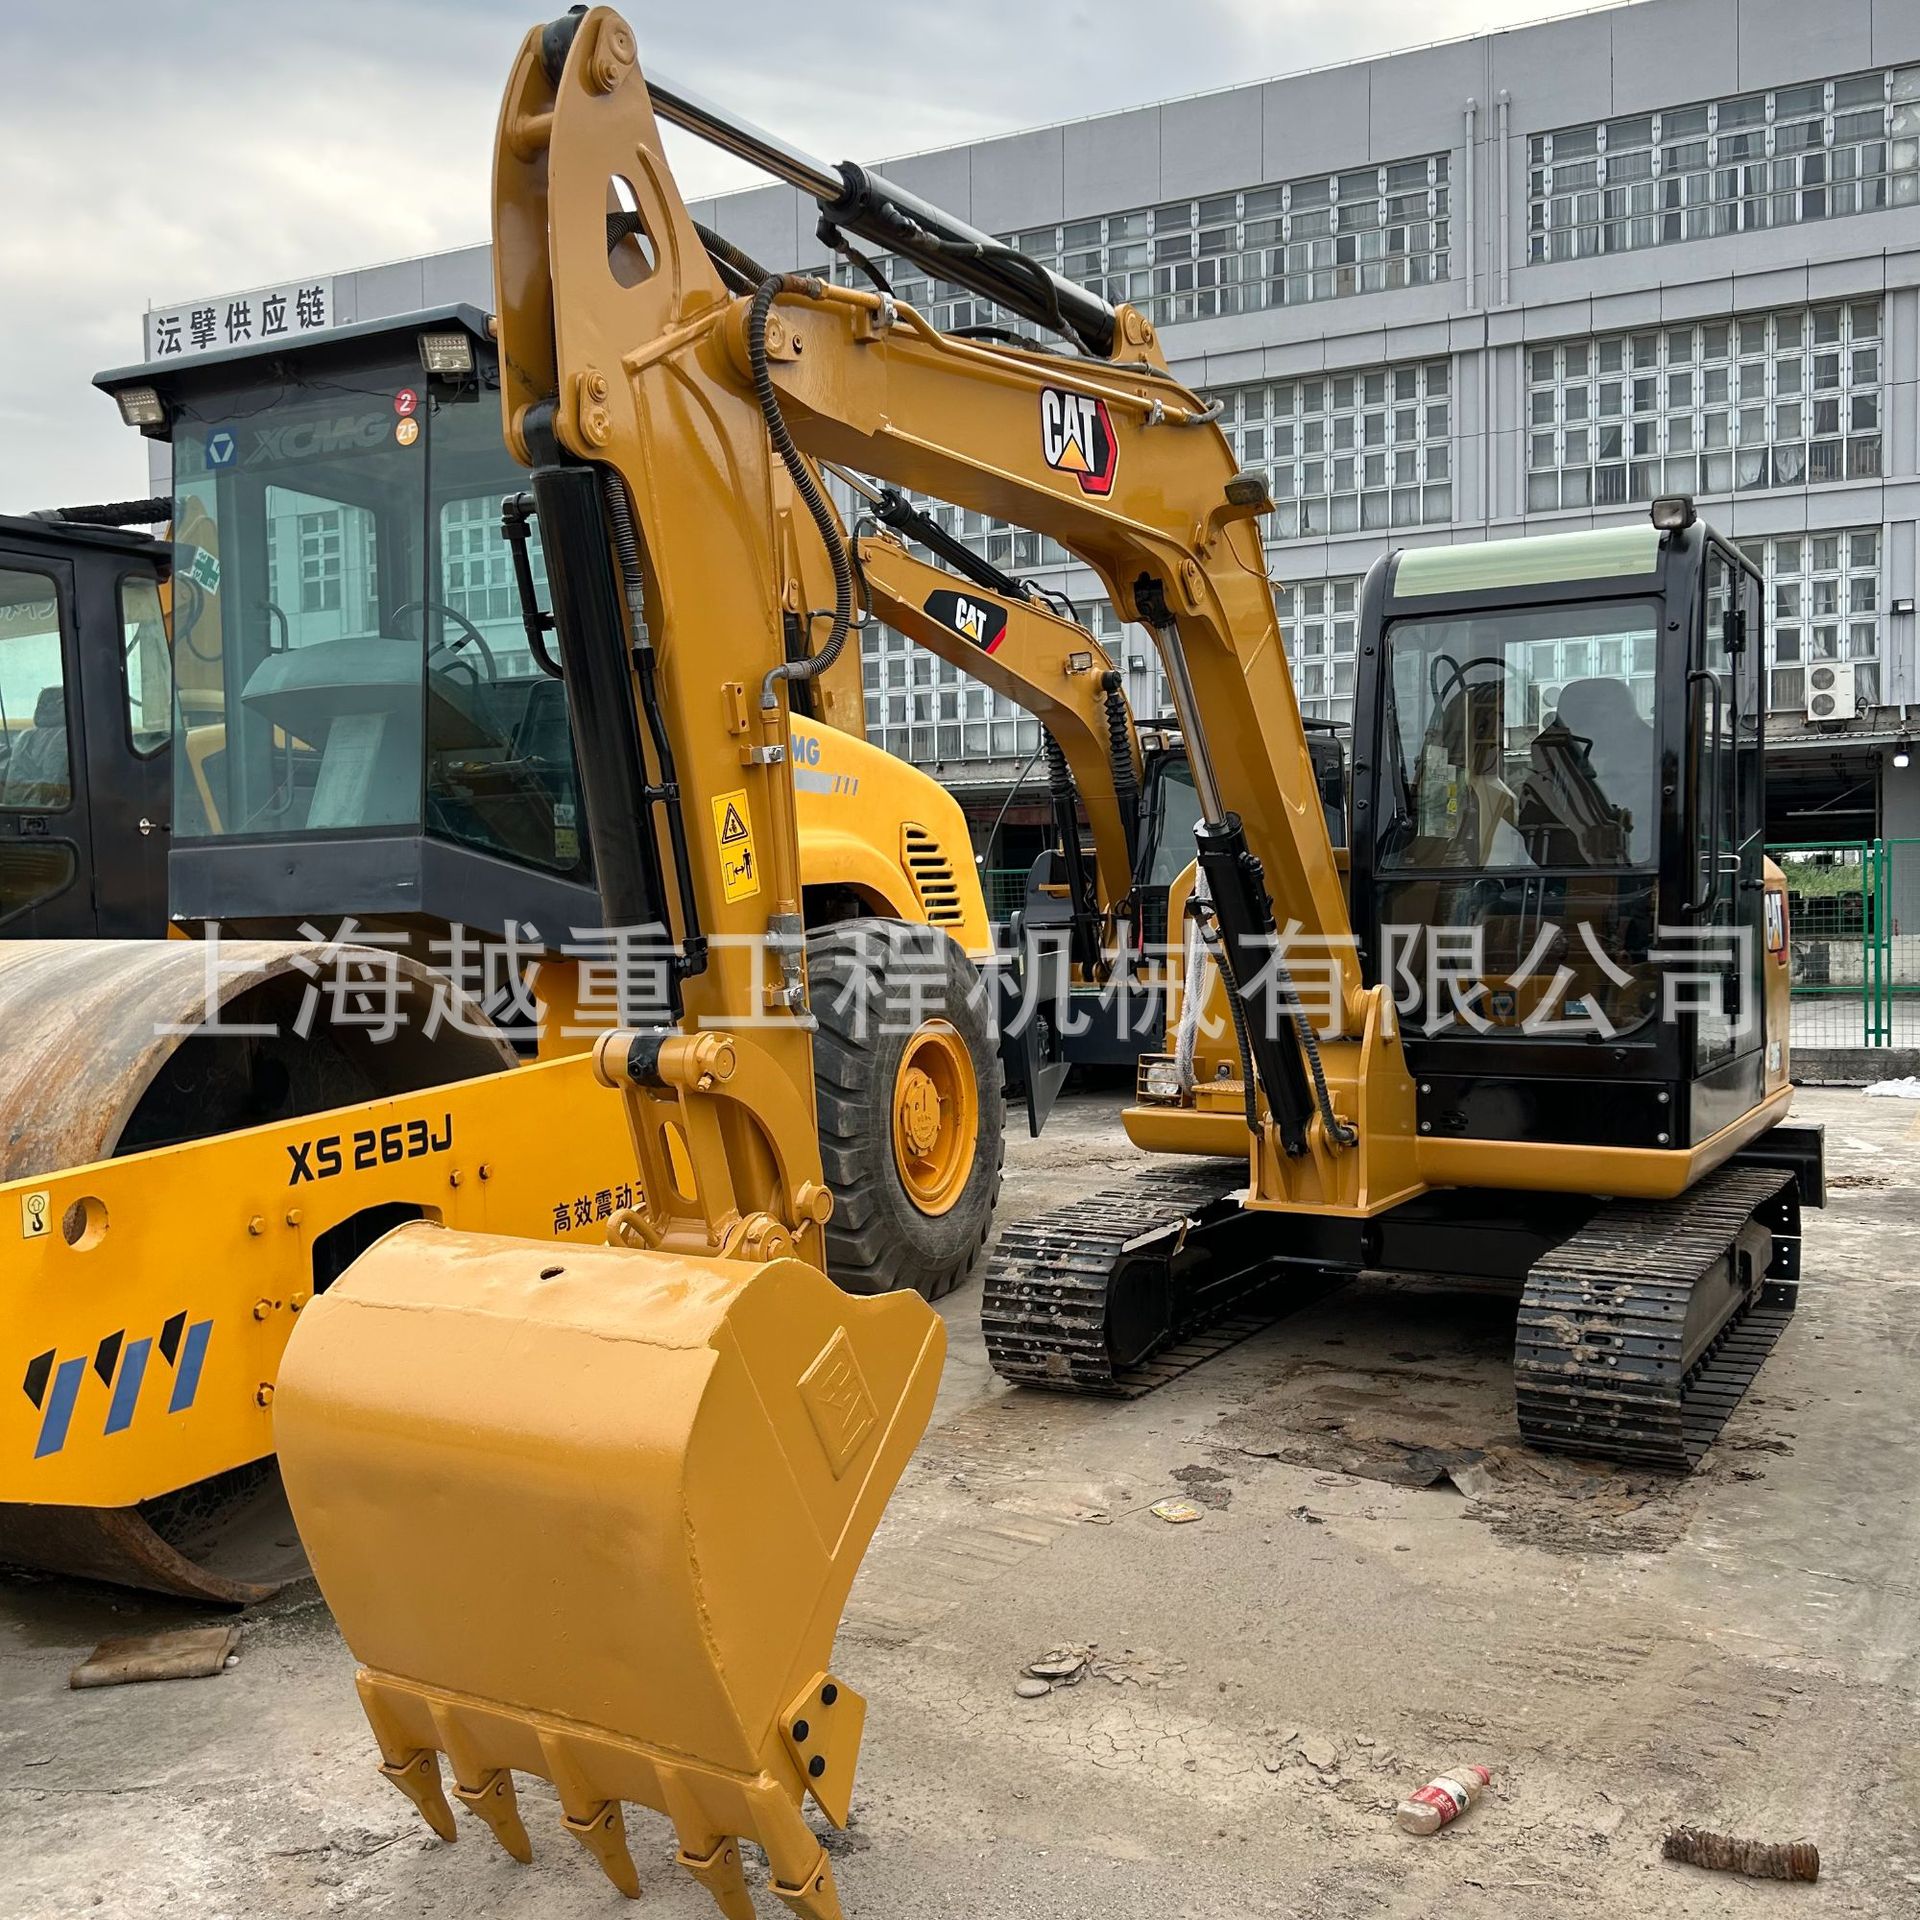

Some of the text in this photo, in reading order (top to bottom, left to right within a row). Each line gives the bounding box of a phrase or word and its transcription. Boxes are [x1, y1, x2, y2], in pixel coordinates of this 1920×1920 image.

[157, 286, 325, 356] 沄擘供应链
[400, 393, 411, 412] 2
[243, 412, 391, 466] XCMG
[397, 422, 417, 440] ZF
[1042, 389, 1096, 473] CAT
[955, 597, 987, 643] CAT
[1764, 893, 1784, 950] CAT
[286, 1113, 453, 1187] XS 263J
